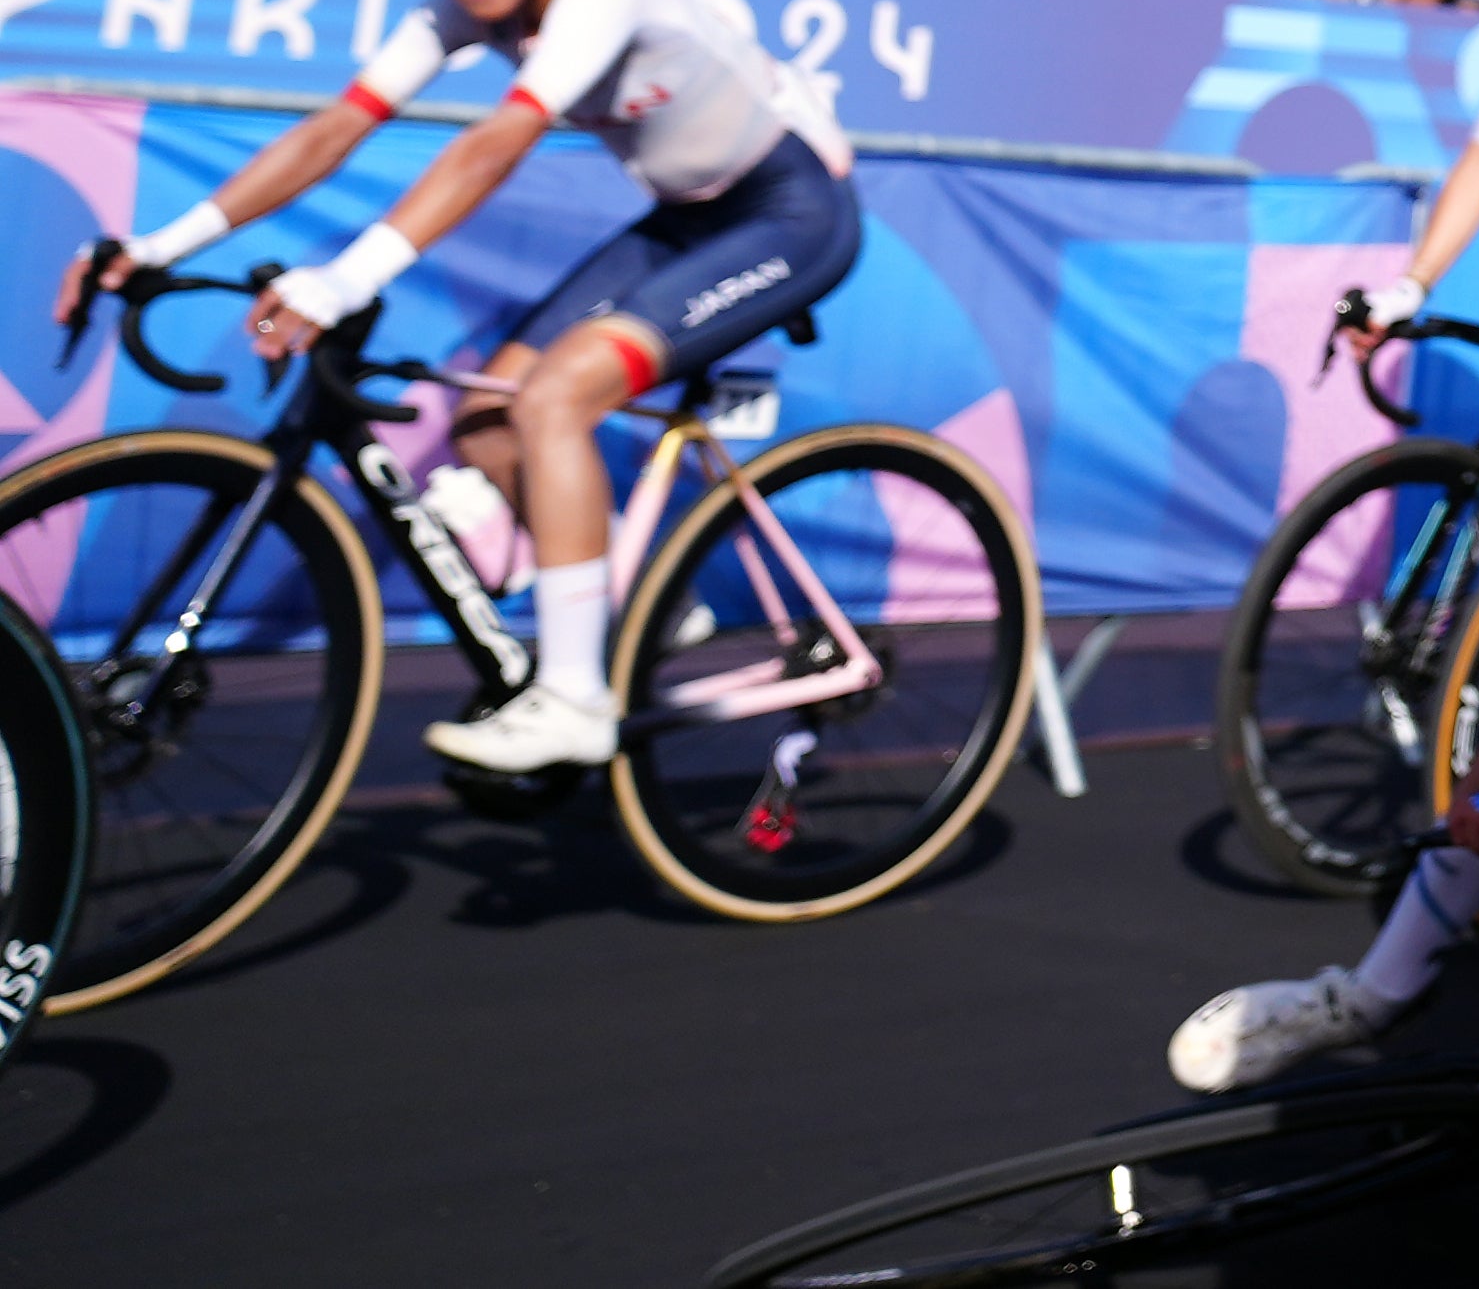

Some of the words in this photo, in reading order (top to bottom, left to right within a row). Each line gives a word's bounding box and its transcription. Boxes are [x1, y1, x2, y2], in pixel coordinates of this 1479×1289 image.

[680, 255, 792, 329] JAPAN
[357, 442, 530, 688] ORBEA
[0, 938, 53, 1050] ISS
